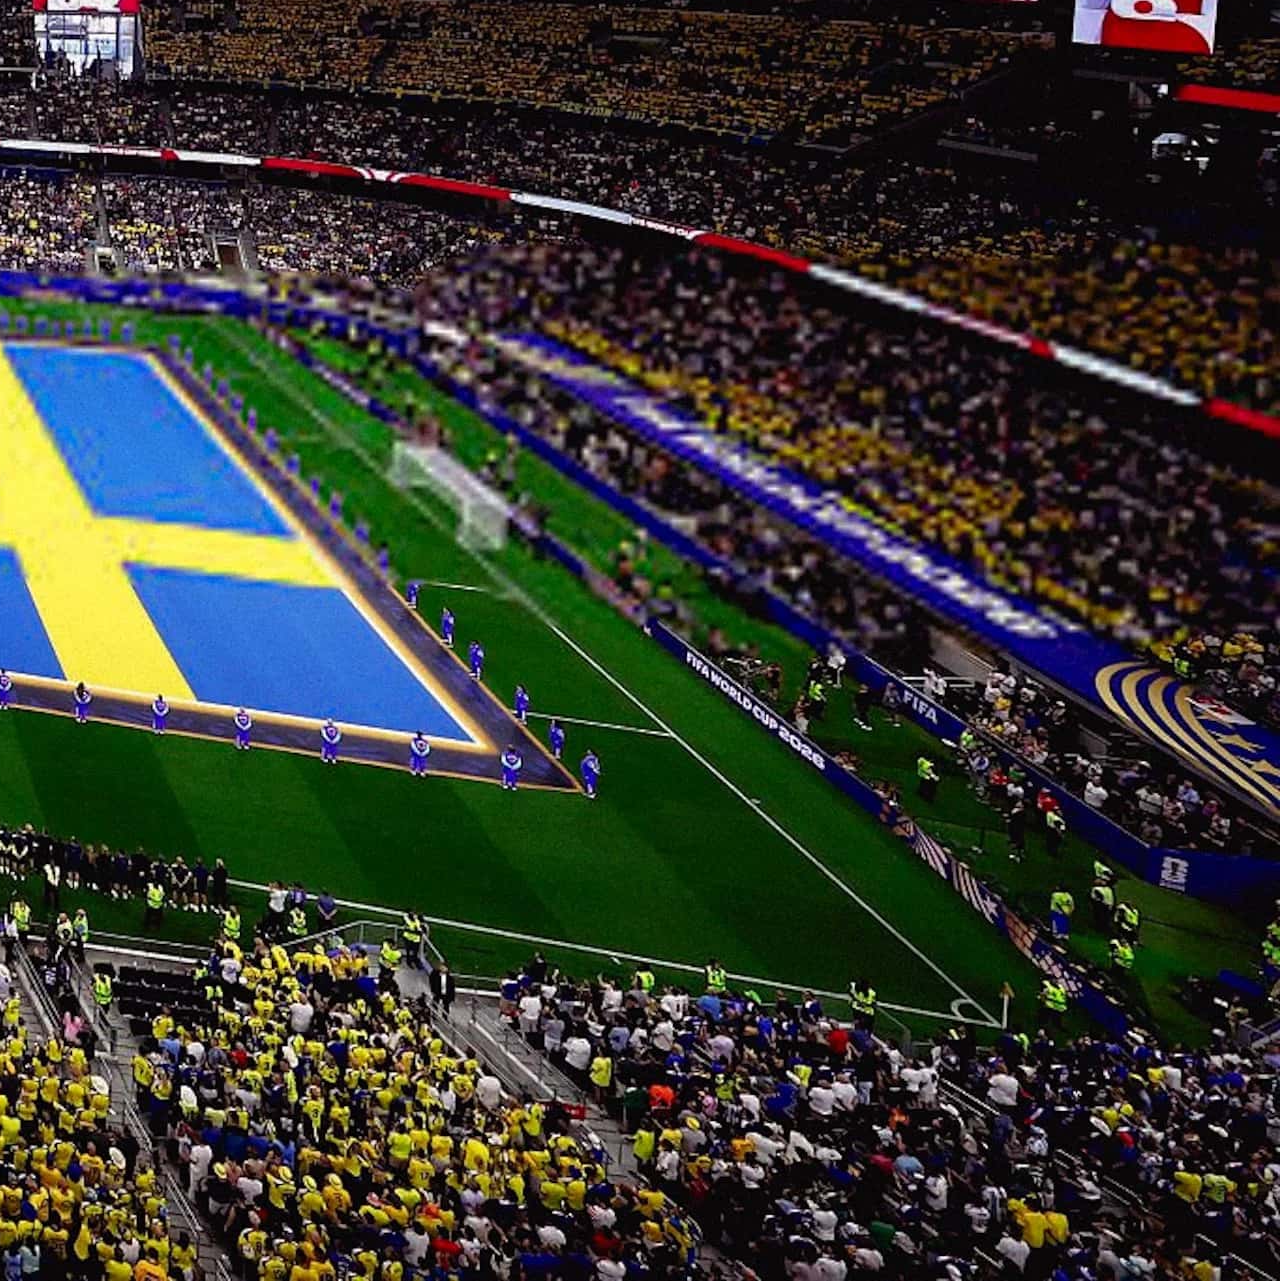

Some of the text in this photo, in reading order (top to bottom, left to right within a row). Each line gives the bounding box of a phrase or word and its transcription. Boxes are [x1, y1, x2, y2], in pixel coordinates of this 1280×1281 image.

[686, 651, 827, 770] FIFA WORLD CUP 2026
[901, 689, 939, 725] FIFA
